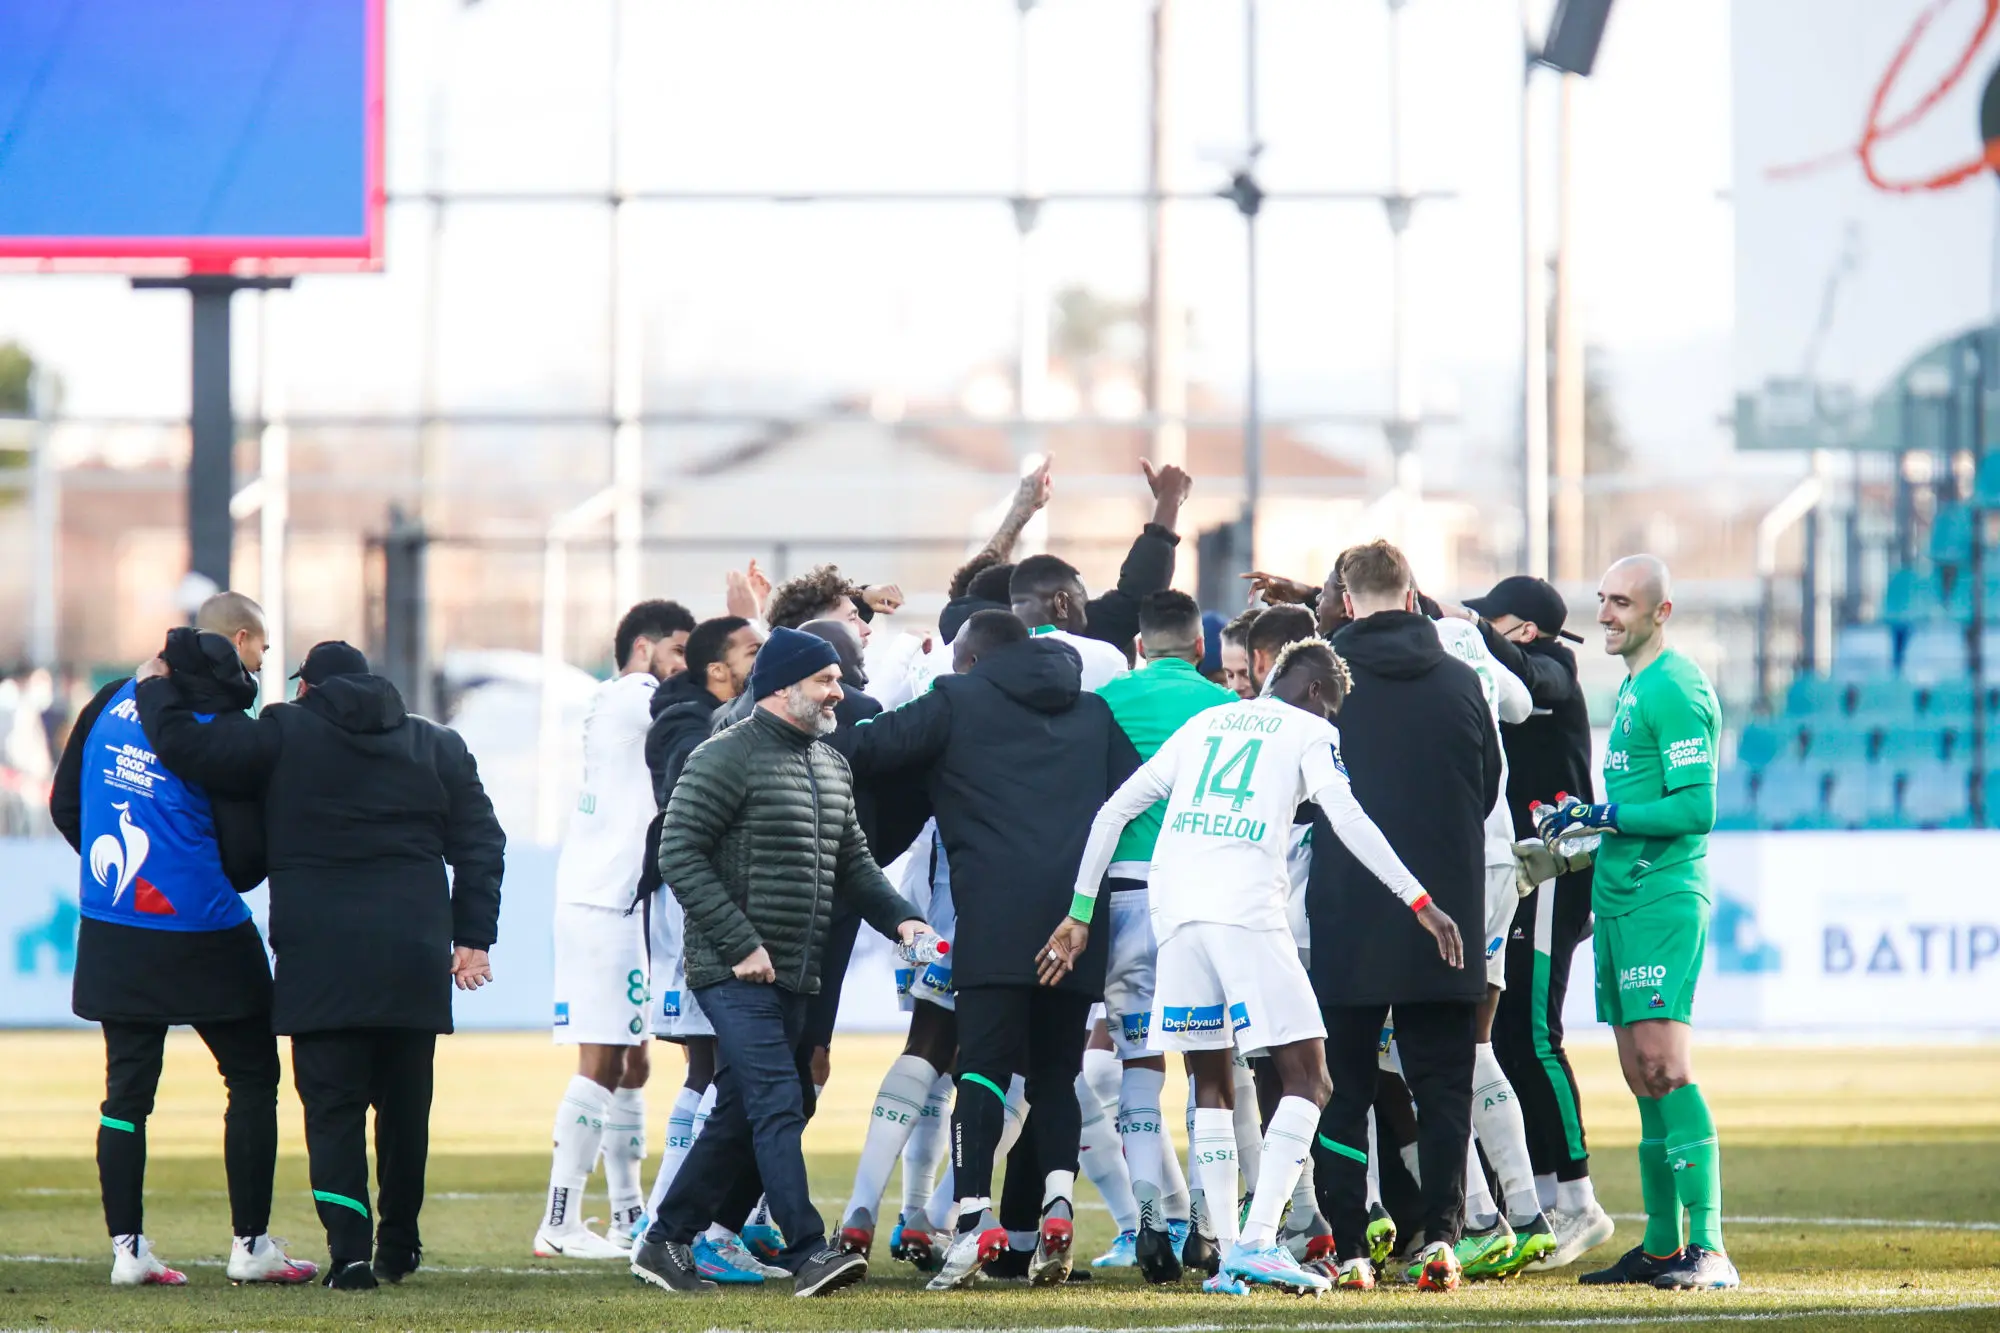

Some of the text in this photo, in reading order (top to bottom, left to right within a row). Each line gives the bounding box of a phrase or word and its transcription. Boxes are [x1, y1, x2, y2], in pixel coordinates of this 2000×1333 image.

[122, 744, 157, 765] SMART
[1669, 747, 1698, 761] GOOD
[1670, 737, 1704, 751] SMART
[115, 754, 146, 773] GOOD
[1671, 754, 1708, 769] THINGS
[115, 766, 153, 788] THINGS
[1191, 736, 1264, 812] 14
[1171, 811, 1267, 842] AFFLELOU
[1164, 1010, 1222, 1034] Desjoyaux
[872, 1105, 911, 1126] SSE
[1195, 1149, 1236, 1165] ASSE
